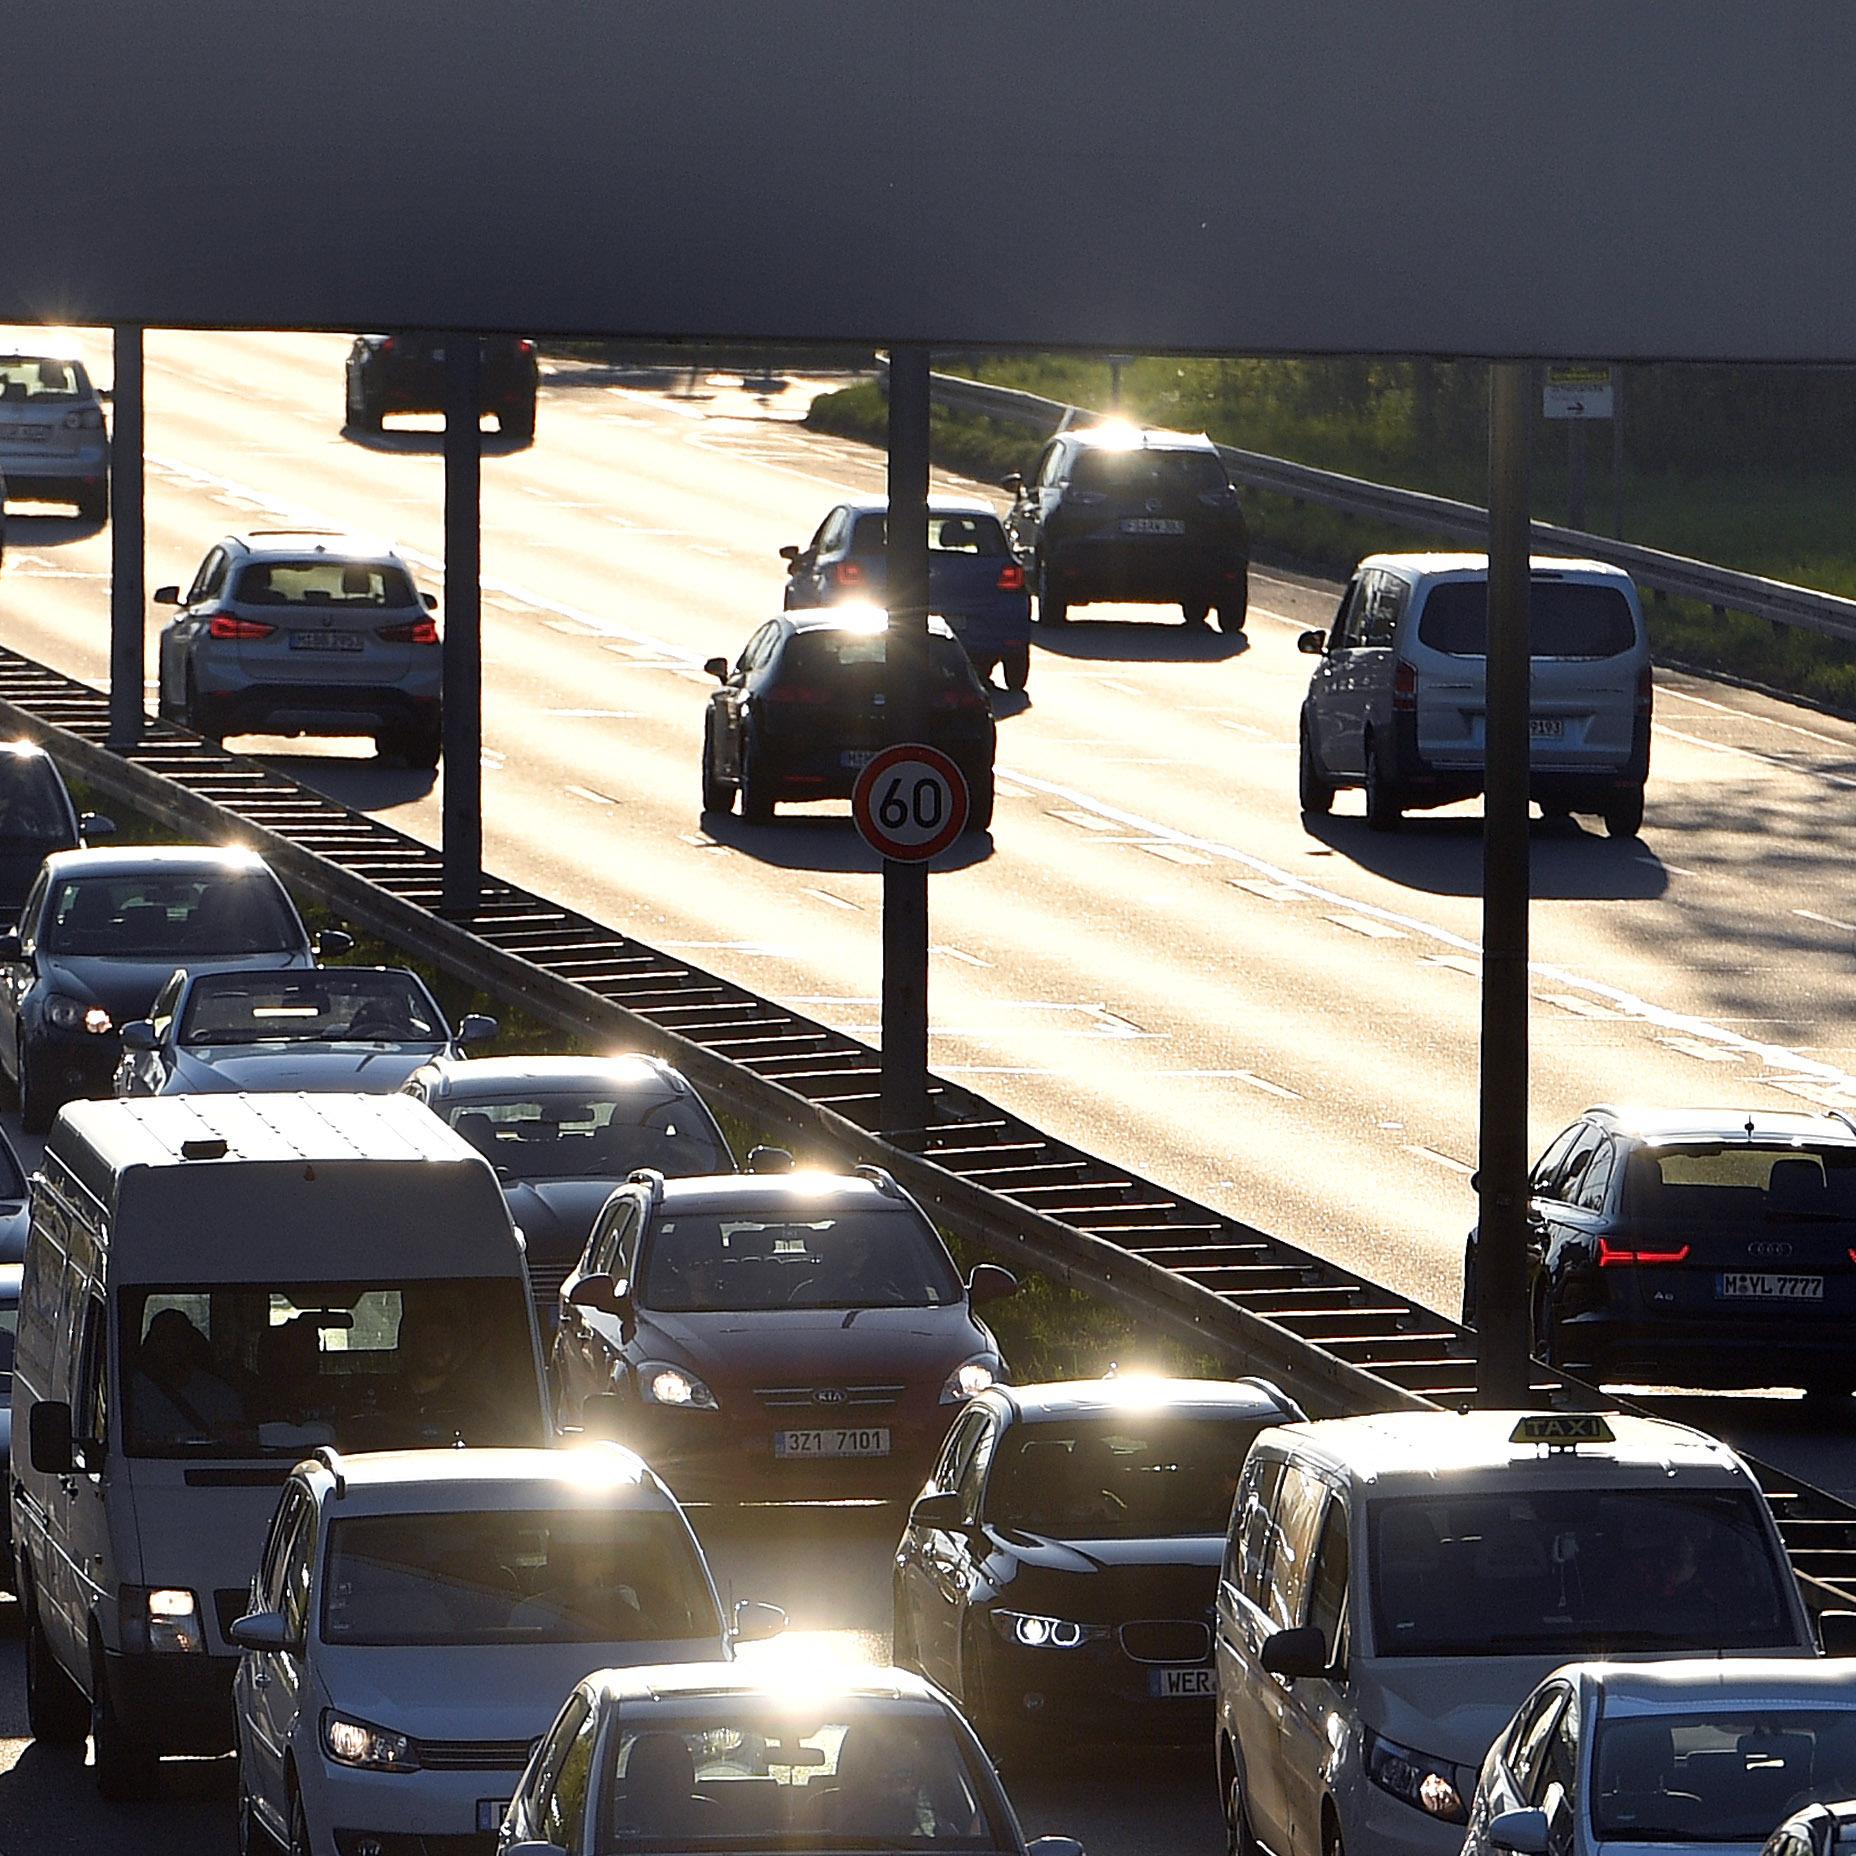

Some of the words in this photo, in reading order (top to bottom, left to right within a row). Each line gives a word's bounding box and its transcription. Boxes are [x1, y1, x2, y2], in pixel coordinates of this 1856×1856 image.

[879, 778, 942, 829] 60
[1725, 1276, 1737, 1293] M
[1749, 1277, 1773, 1294] YL
[1777, 1277, 1822, 1296] 7777
[1527, 1420, 1599, 1436] TAXI
[789, 1432, 822, 1451] 3Z1
[836, 1431, 882, 1450] 7101
[1167, 1672, 1211, 1692] WER
